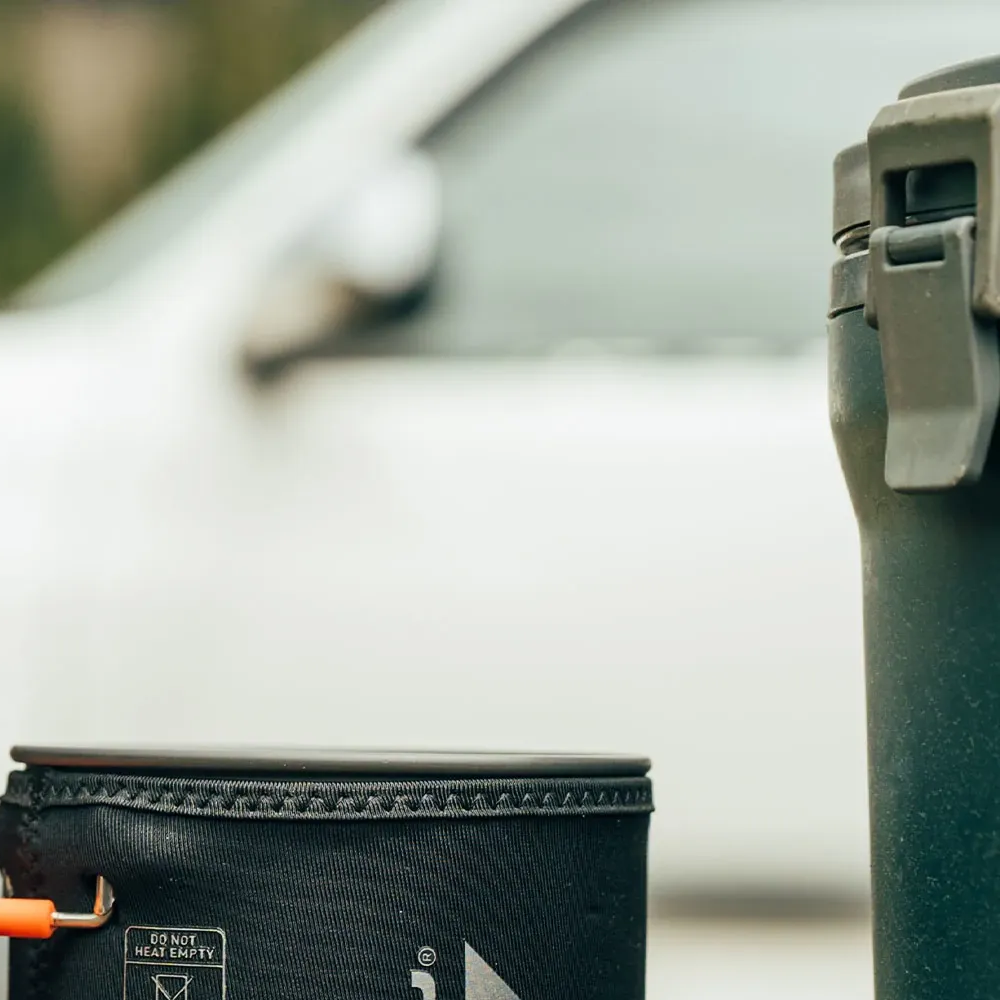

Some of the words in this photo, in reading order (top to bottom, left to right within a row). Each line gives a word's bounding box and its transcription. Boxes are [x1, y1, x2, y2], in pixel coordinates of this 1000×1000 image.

[150, 933, 168, 945] DO
[171, 934, 197, 946] NOT
[135, 946, 166, 958] HEAT
[169, 947, 215, 960] EMPTY
